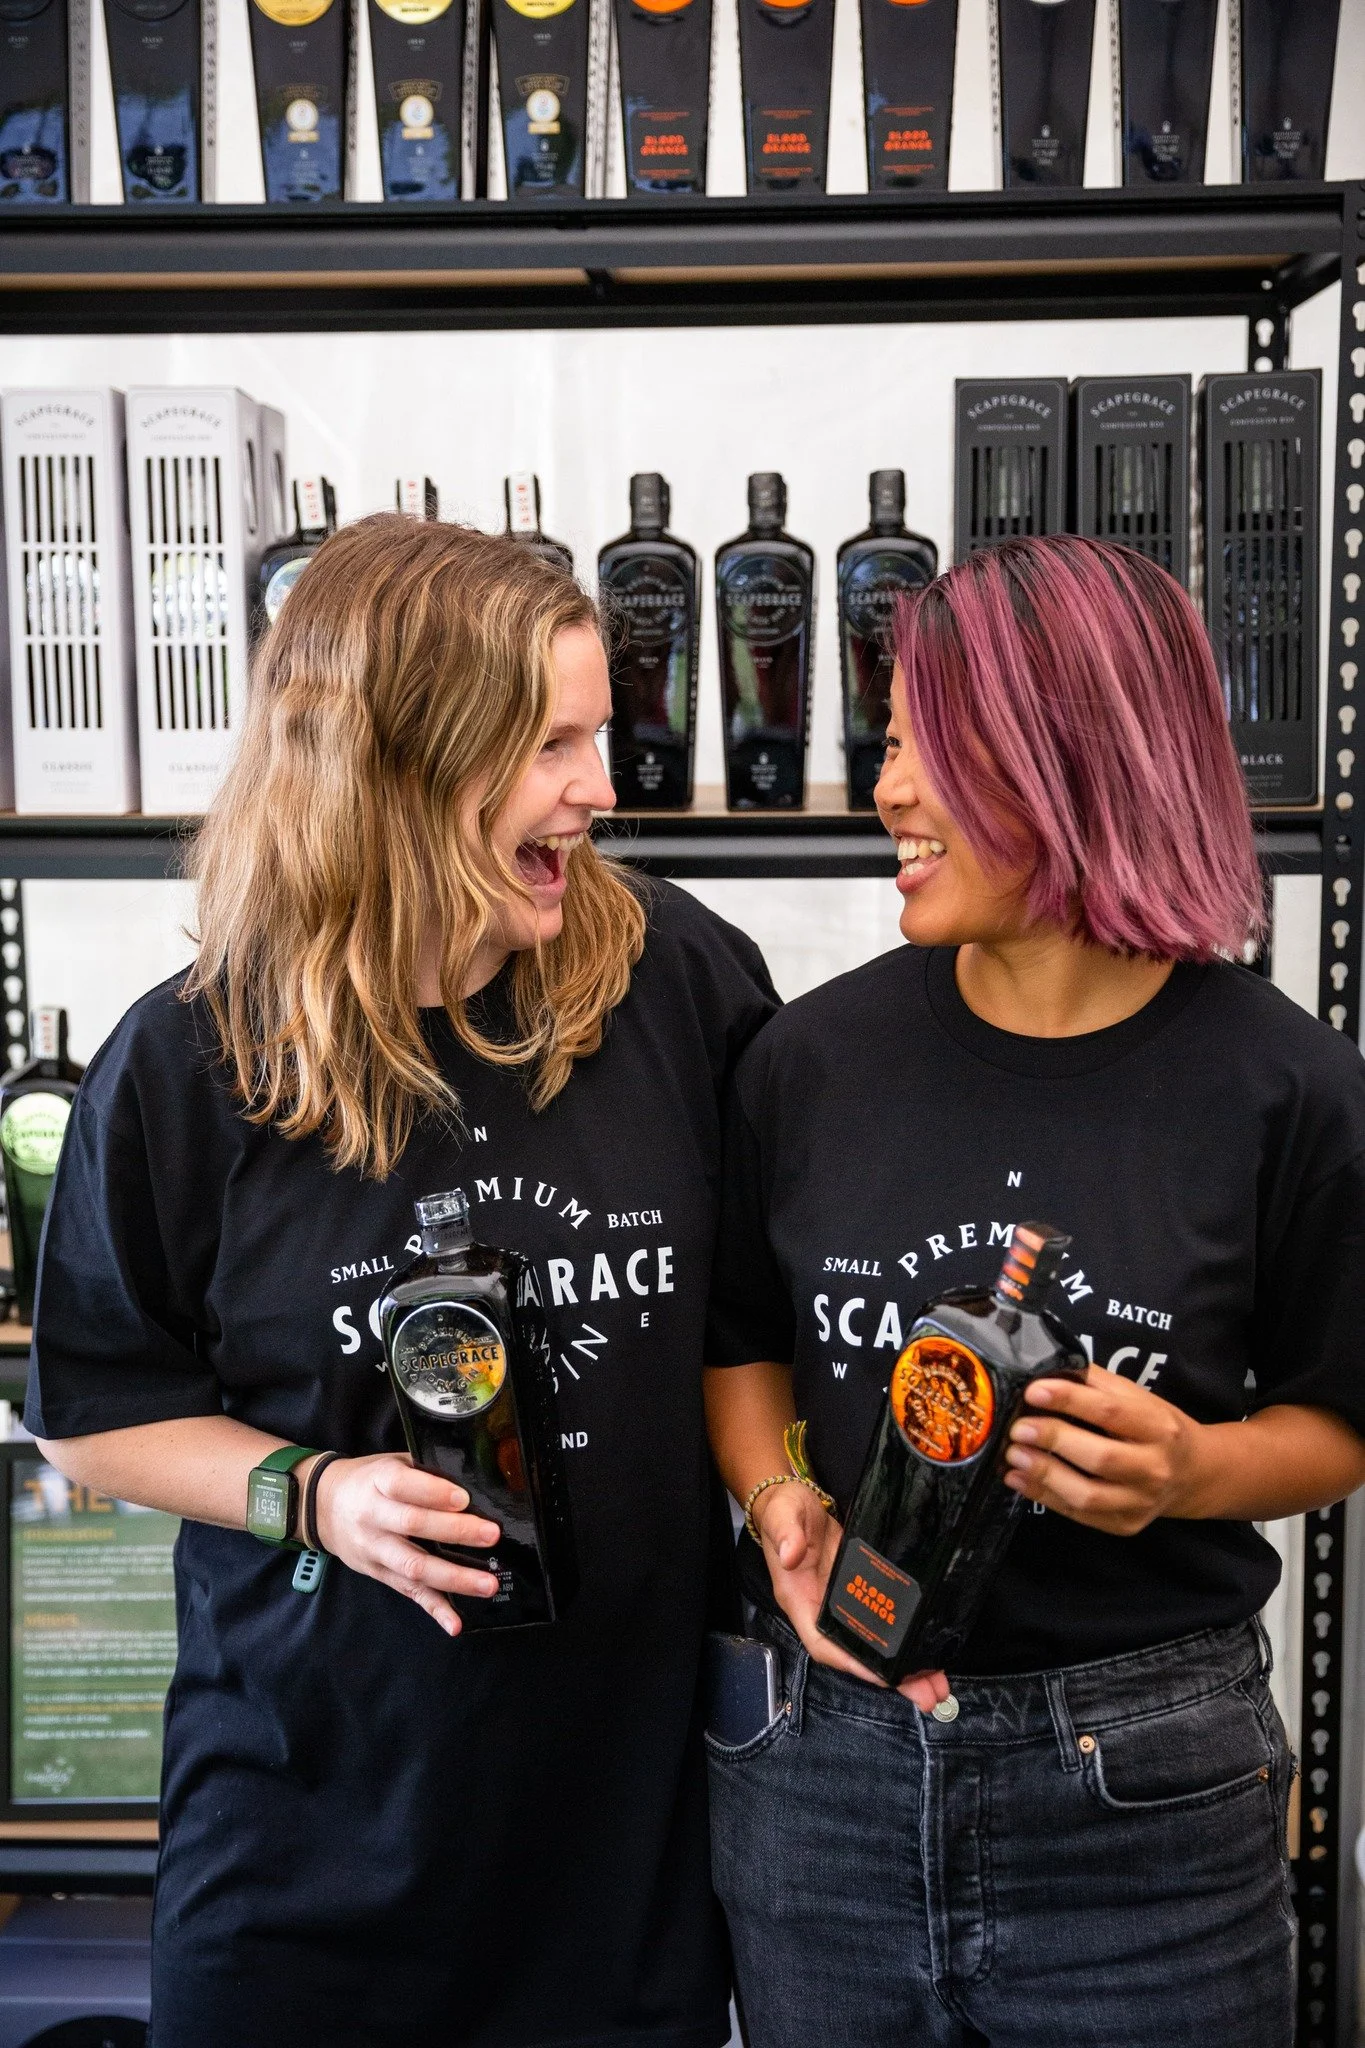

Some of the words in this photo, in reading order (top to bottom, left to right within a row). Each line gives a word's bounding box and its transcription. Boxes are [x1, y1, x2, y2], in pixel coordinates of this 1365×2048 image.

[1240, 754, 1284, 765] BLACK
[473, 1126, 488, 1142] N
[1007, 1170, 1022, 1187] N
[607, 1209, 663, 1229] BATCH
[330, 1255, 394, 1284] SMALL
[822, 1256, 882, 1277] SMALL
[640, 1312, 650, 1328] E
[1106, 1299, 1172, 1331] BATCH
[400, 1345, 499, 1373] SCAPEGRACE
[832, 1362, 848, 1379] W
[255, 1497, 281, 1517] 15:51
[854, 1574, 895, 1611] BLOOD
[846, 1582, 896, 1626] ORANGE
